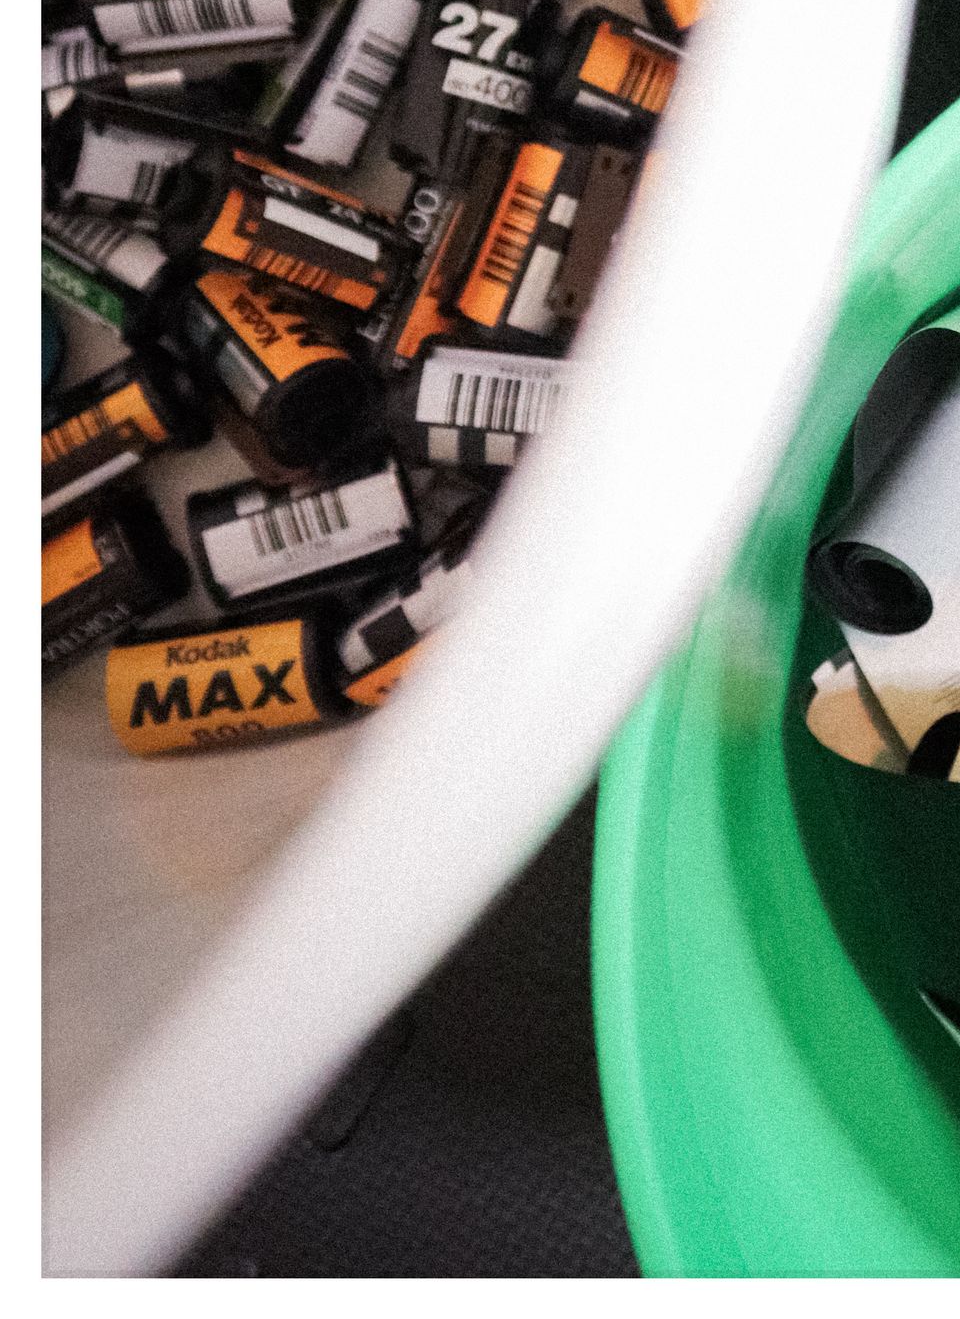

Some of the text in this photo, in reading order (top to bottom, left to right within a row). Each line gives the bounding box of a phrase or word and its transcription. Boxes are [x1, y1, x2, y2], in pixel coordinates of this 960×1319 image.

[431, 1, 520, 63] 27
[472, 73, 531, 108] 400
[165, 634, 252, 668] Kodak
[129, 659, 298, 730] MAX
